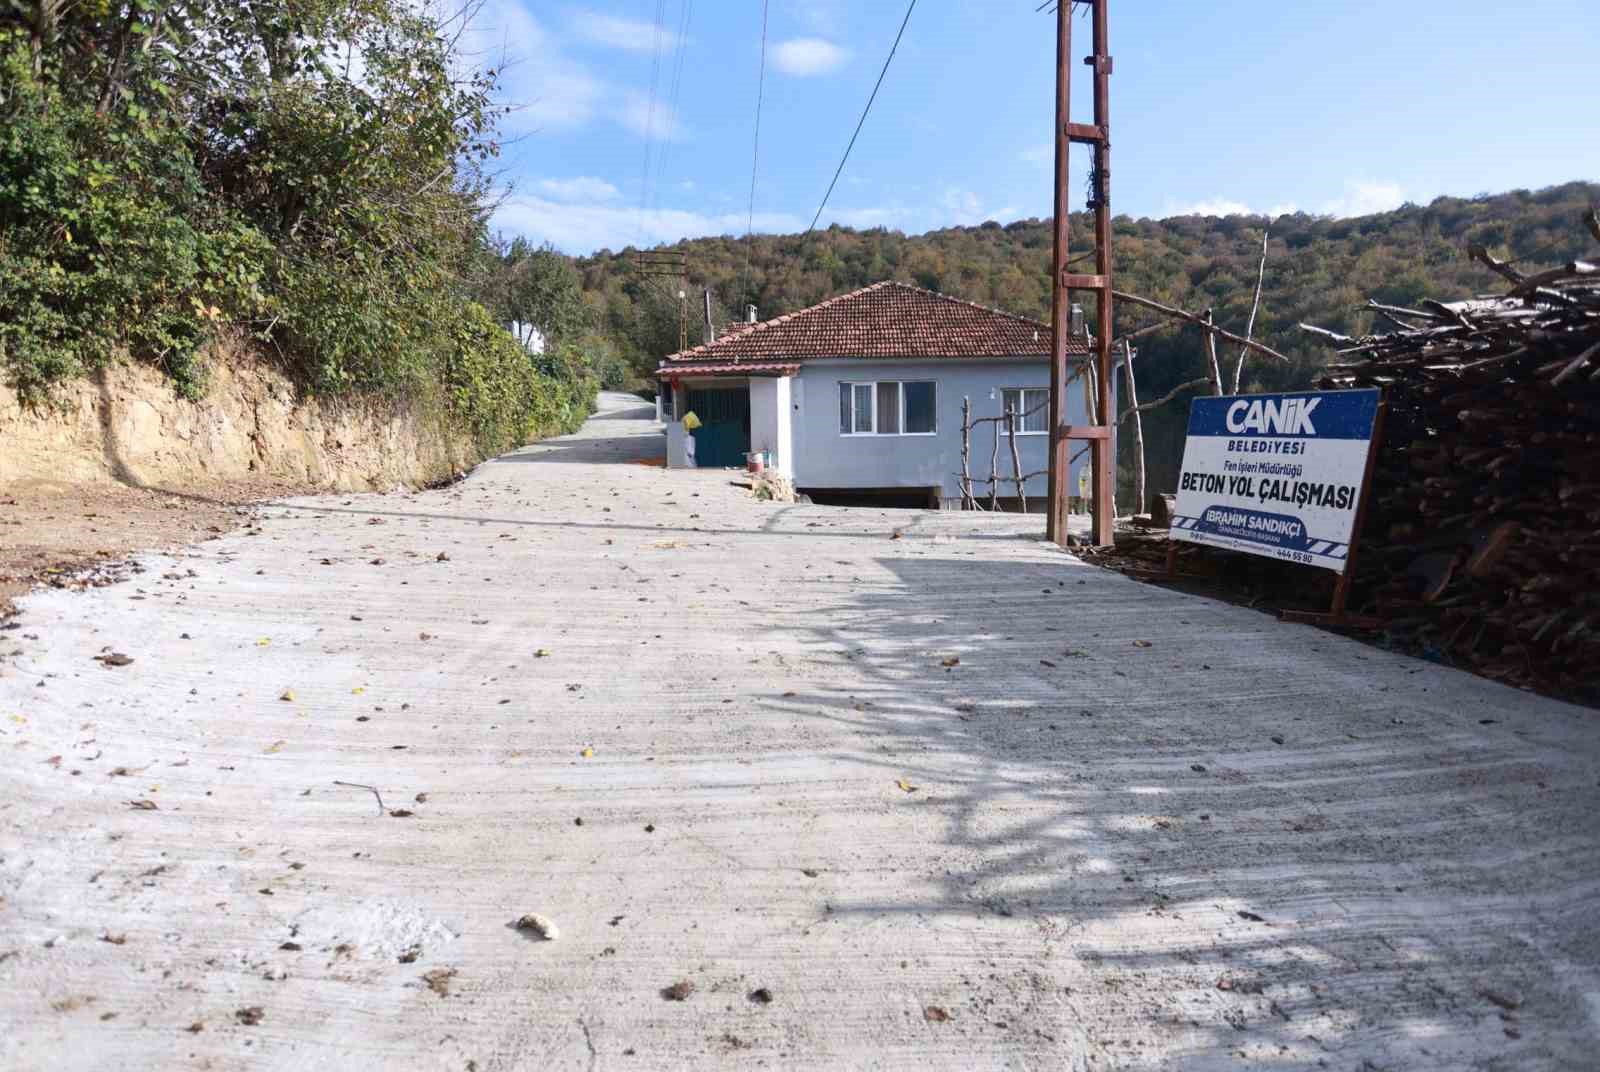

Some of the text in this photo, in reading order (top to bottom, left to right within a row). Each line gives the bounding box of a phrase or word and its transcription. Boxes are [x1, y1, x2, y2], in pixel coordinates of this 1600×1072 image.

[1223, 457, 1303, 478] Fen İşleri Müdürlüğü
[1181, 472, 1356, 510] BETON YOL ÇALIŞMASI
[1247, 516, 1302, 538] SANDIKÇI
[1276, 549, 1291, 560] 444
[1302, 553, 1313, 564] 90
